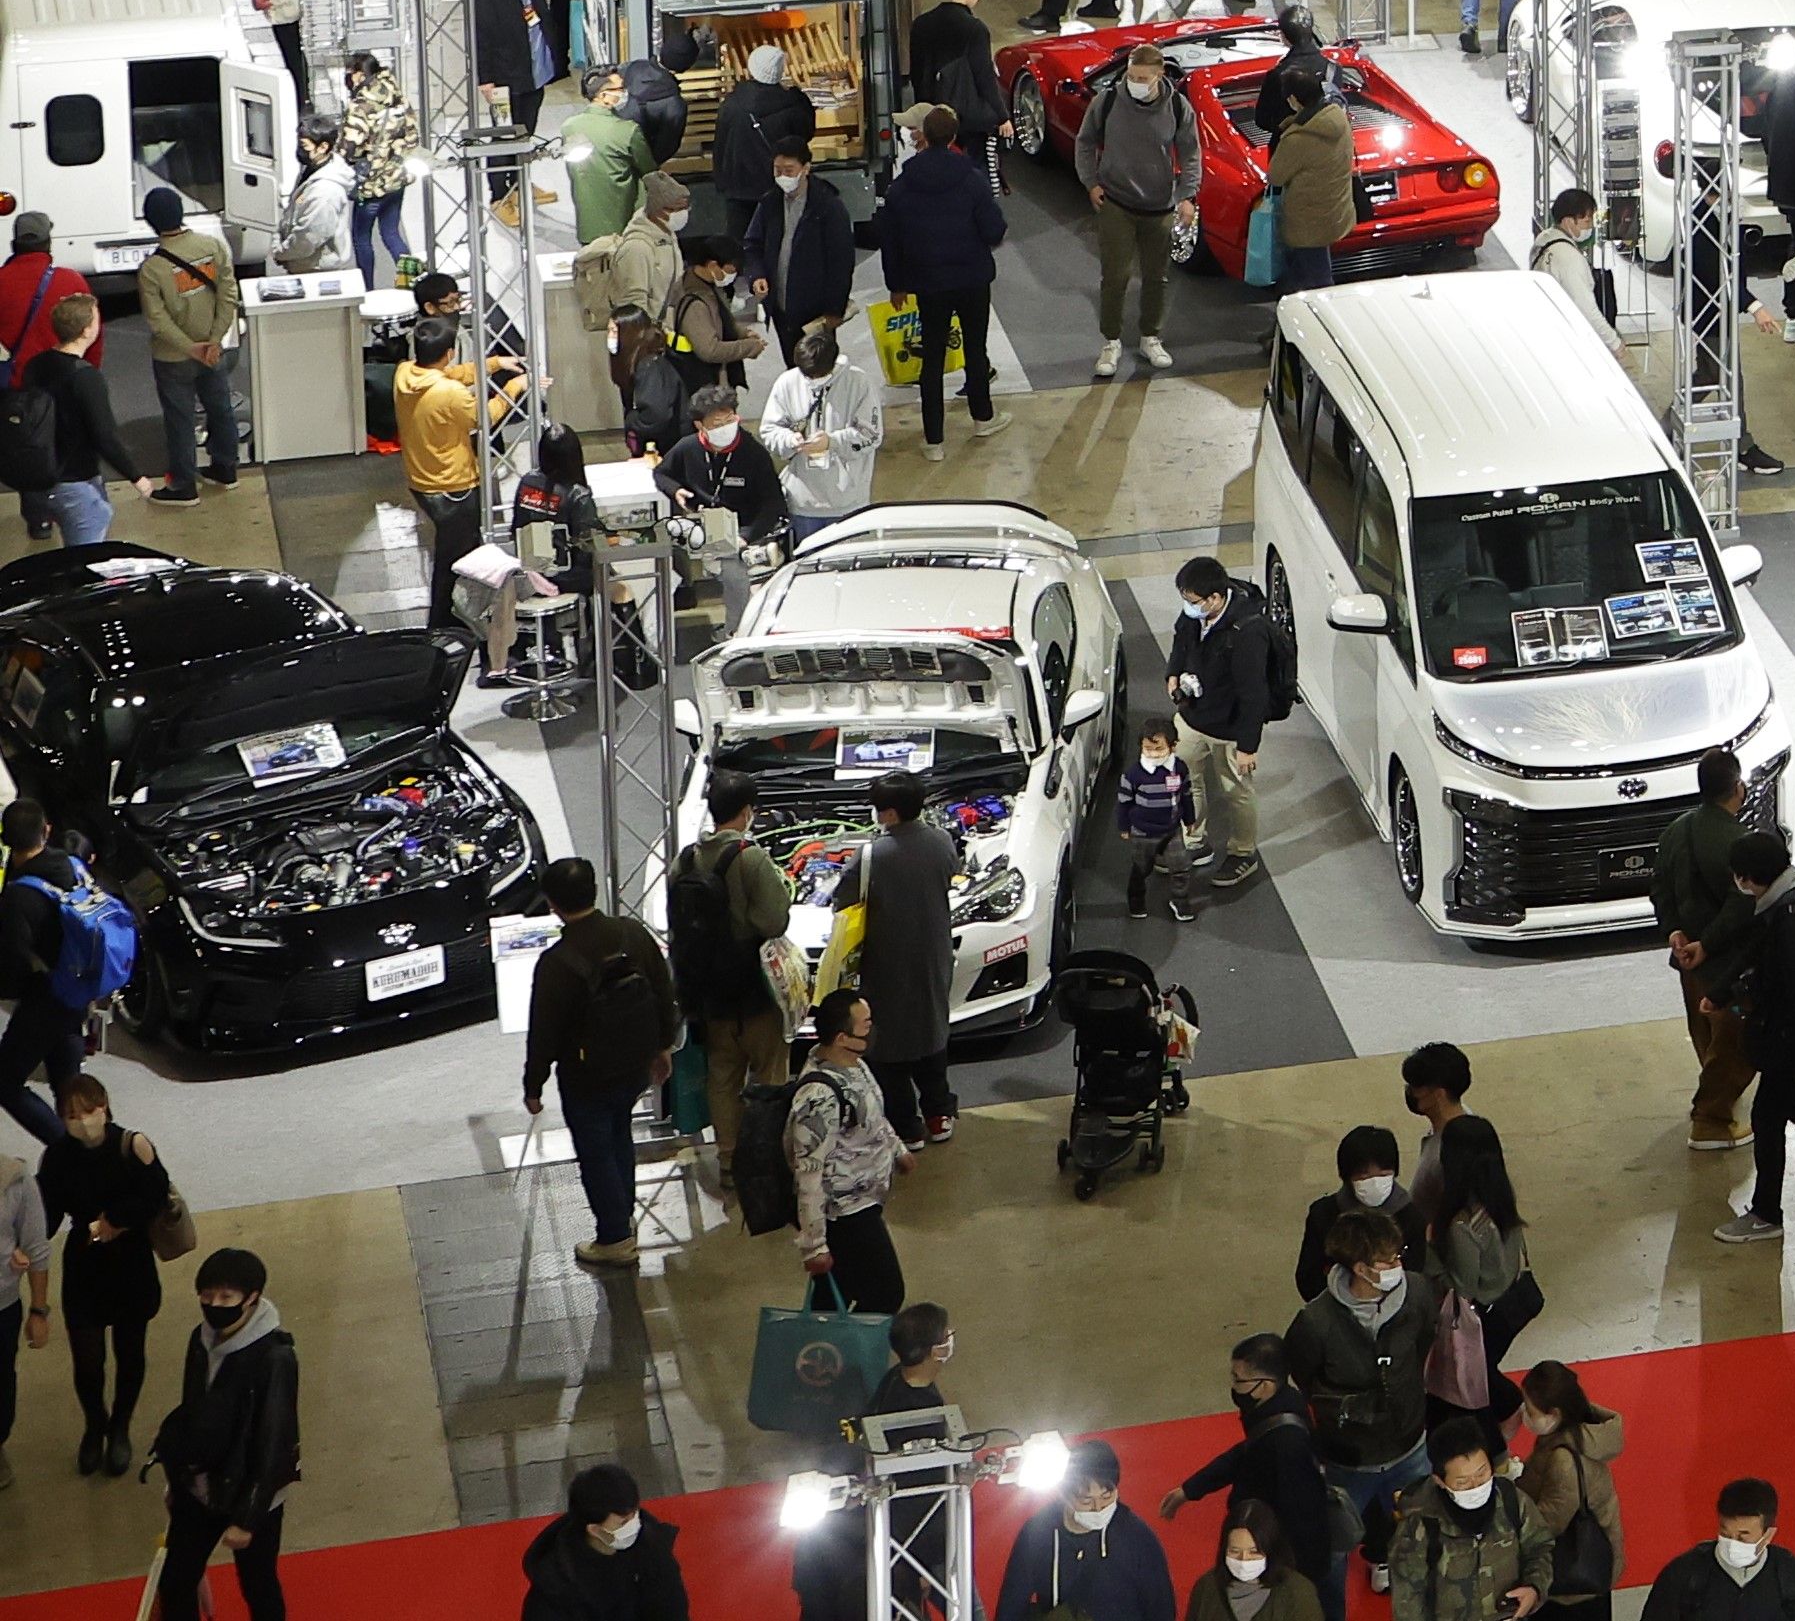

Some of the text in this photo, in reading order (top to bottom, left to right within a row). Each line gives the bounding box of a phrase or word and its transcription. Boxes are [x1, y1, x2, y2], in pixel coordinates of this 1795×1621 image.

[1516, 499, 1588, 515] ROHAN
[1588, 497, 1614, 507] Body
[1614, 494, 1642, 504] Work
[986, 937, 1028, 962] MOTUL
